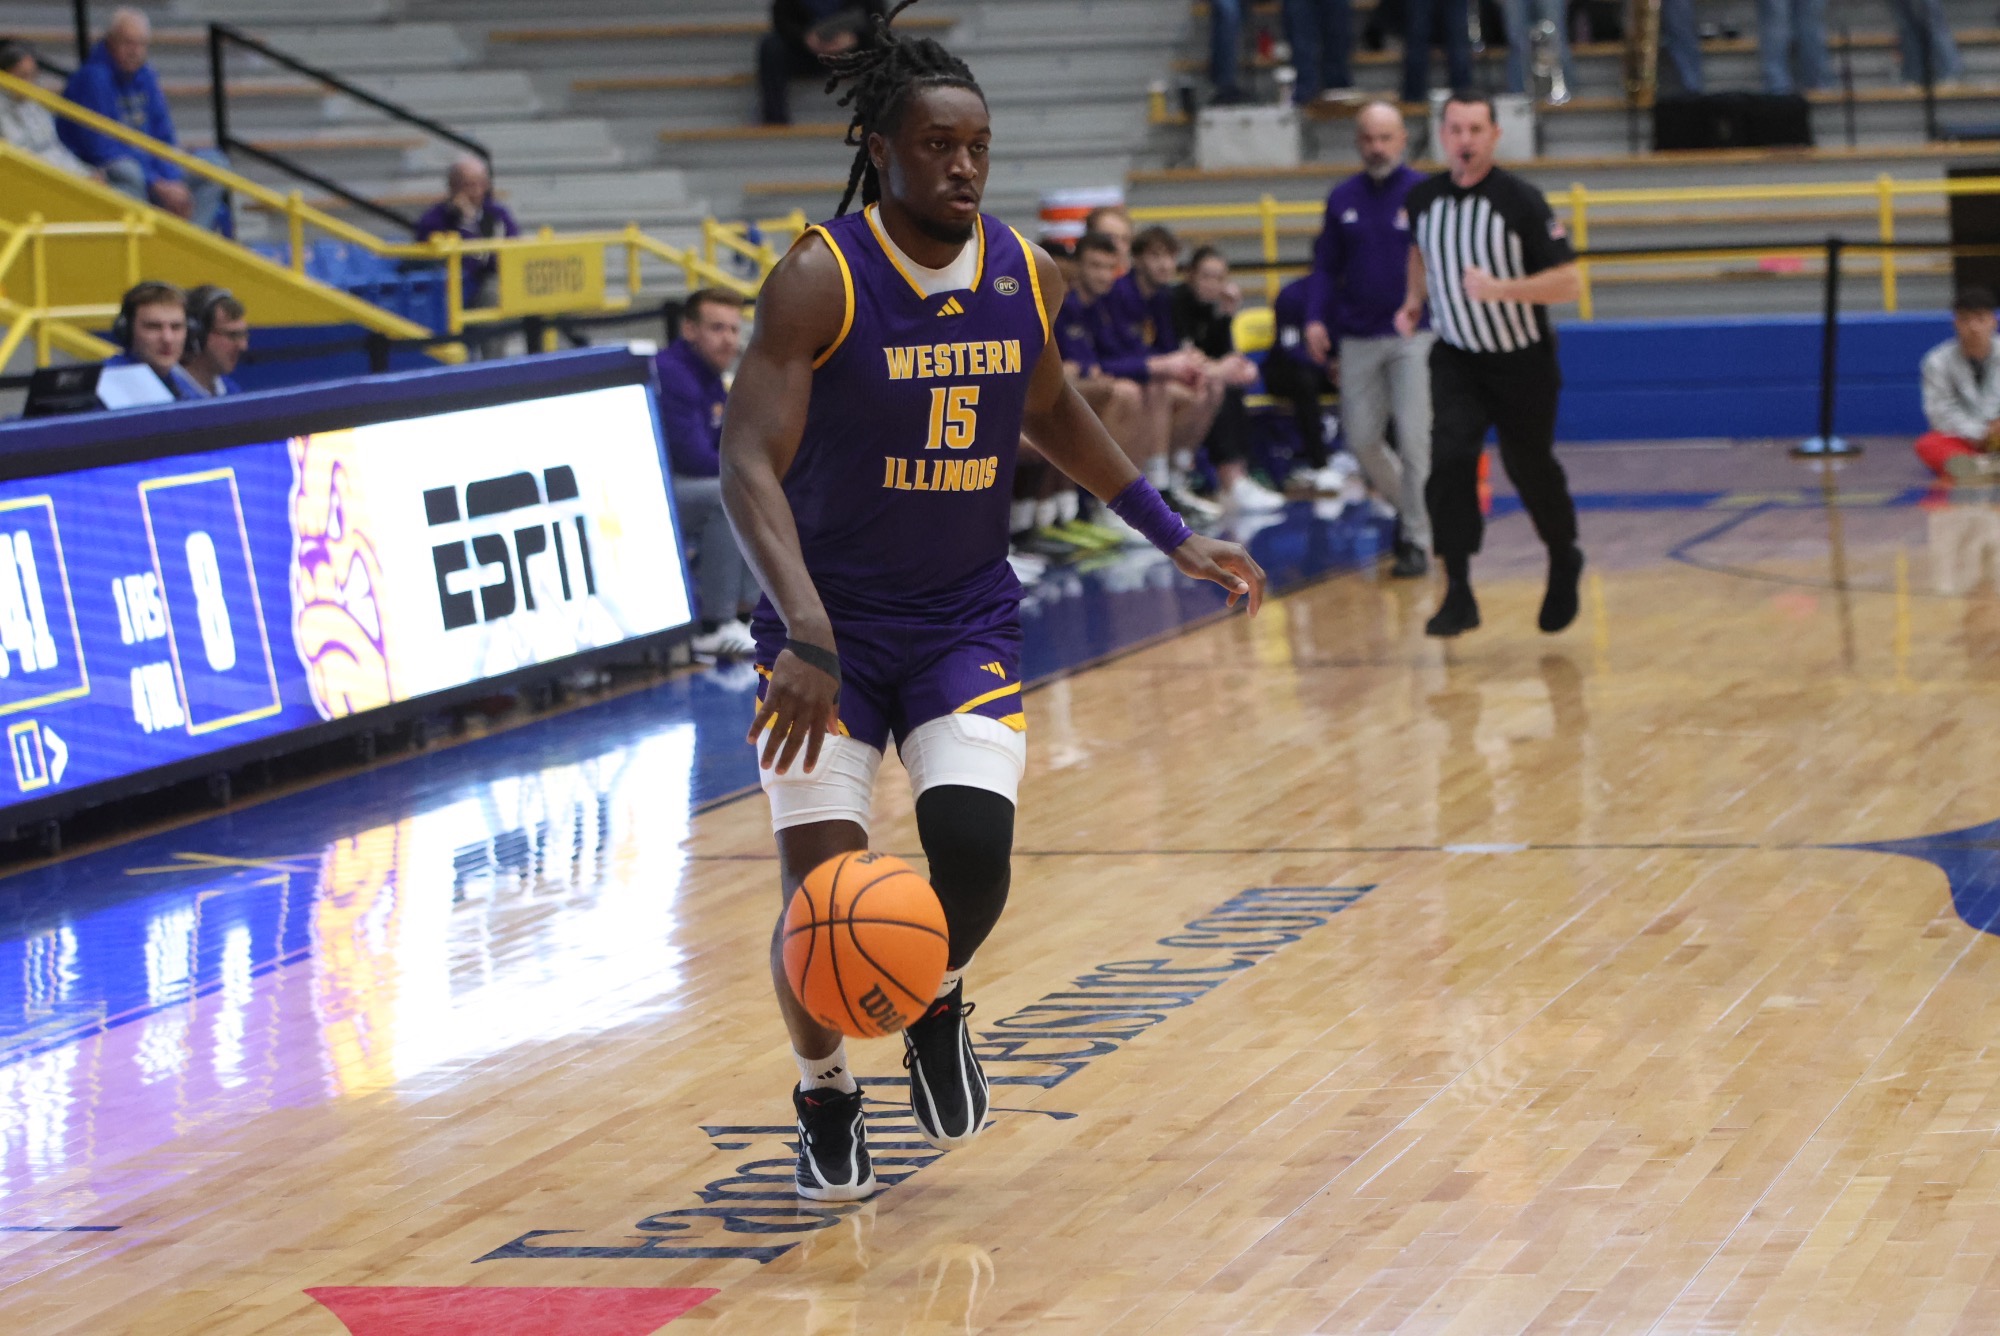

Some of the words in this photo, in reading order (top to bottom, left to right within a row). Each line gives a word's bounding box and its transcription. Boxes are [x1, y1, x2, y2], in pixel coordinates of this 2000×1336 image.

[883, 339, 1021, 381] WESTERN
[924, 385, 980, 450] 15
[882, 456, 998, 492] ILLINOIS
[423, 465, 595, 632] ESPN
